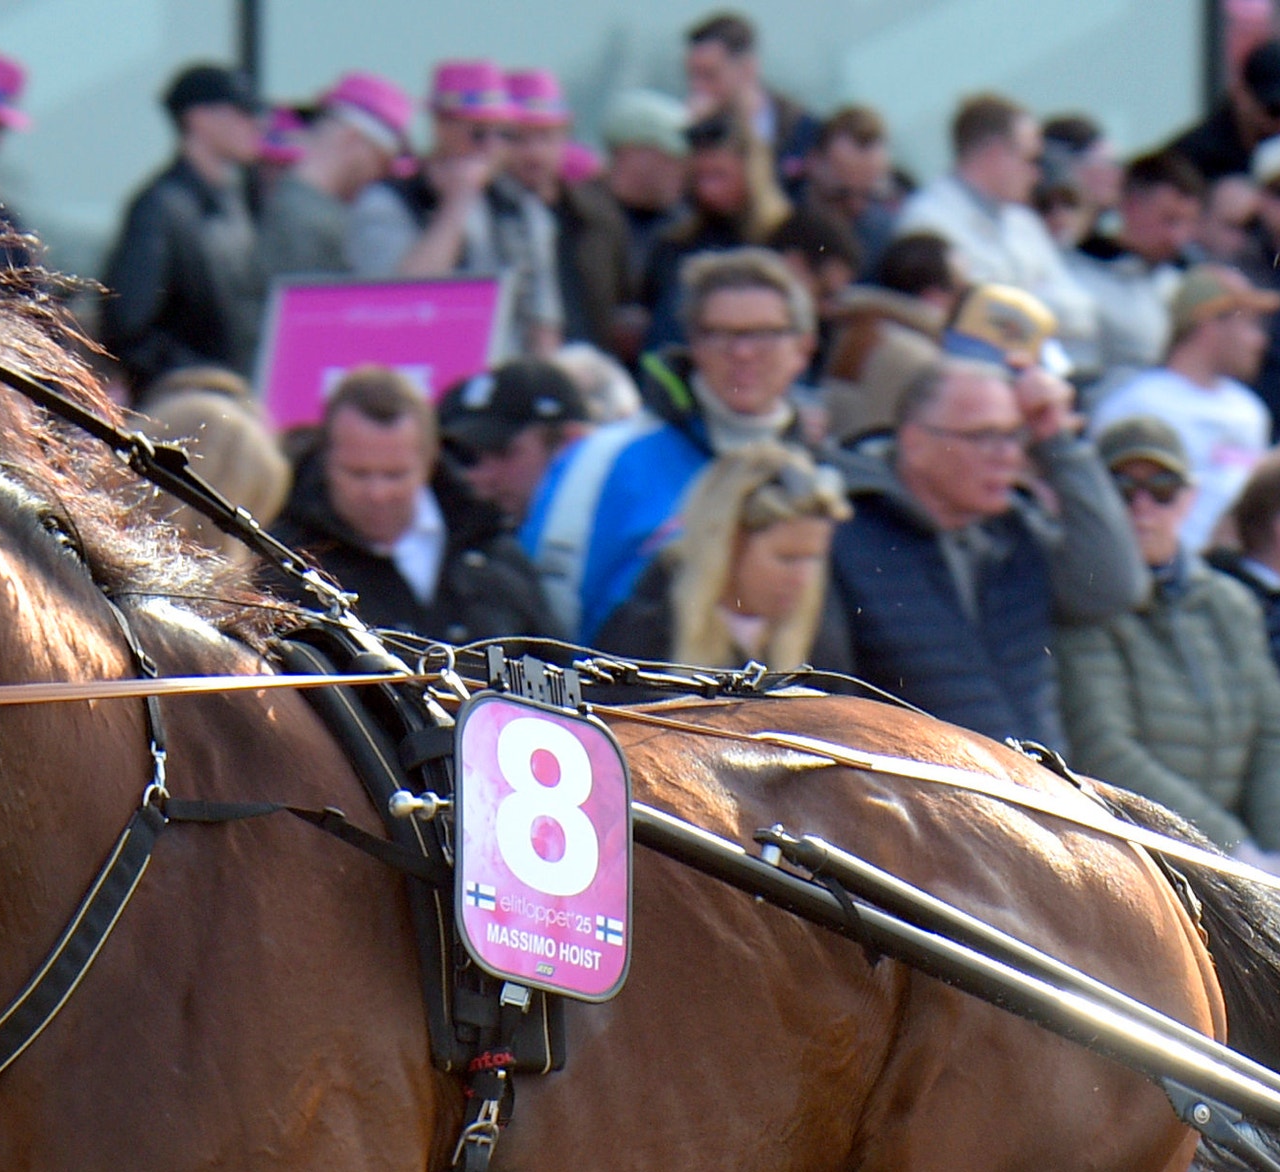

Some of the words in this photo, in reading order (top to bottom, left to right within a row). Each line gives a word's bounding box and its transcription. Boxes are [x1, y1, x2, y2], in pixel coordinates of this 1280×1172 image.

[496, 716, 600, 897] 8
[486, 923, 556, 958] MASSIMO
[559, 942, 602, 971] HOIST
